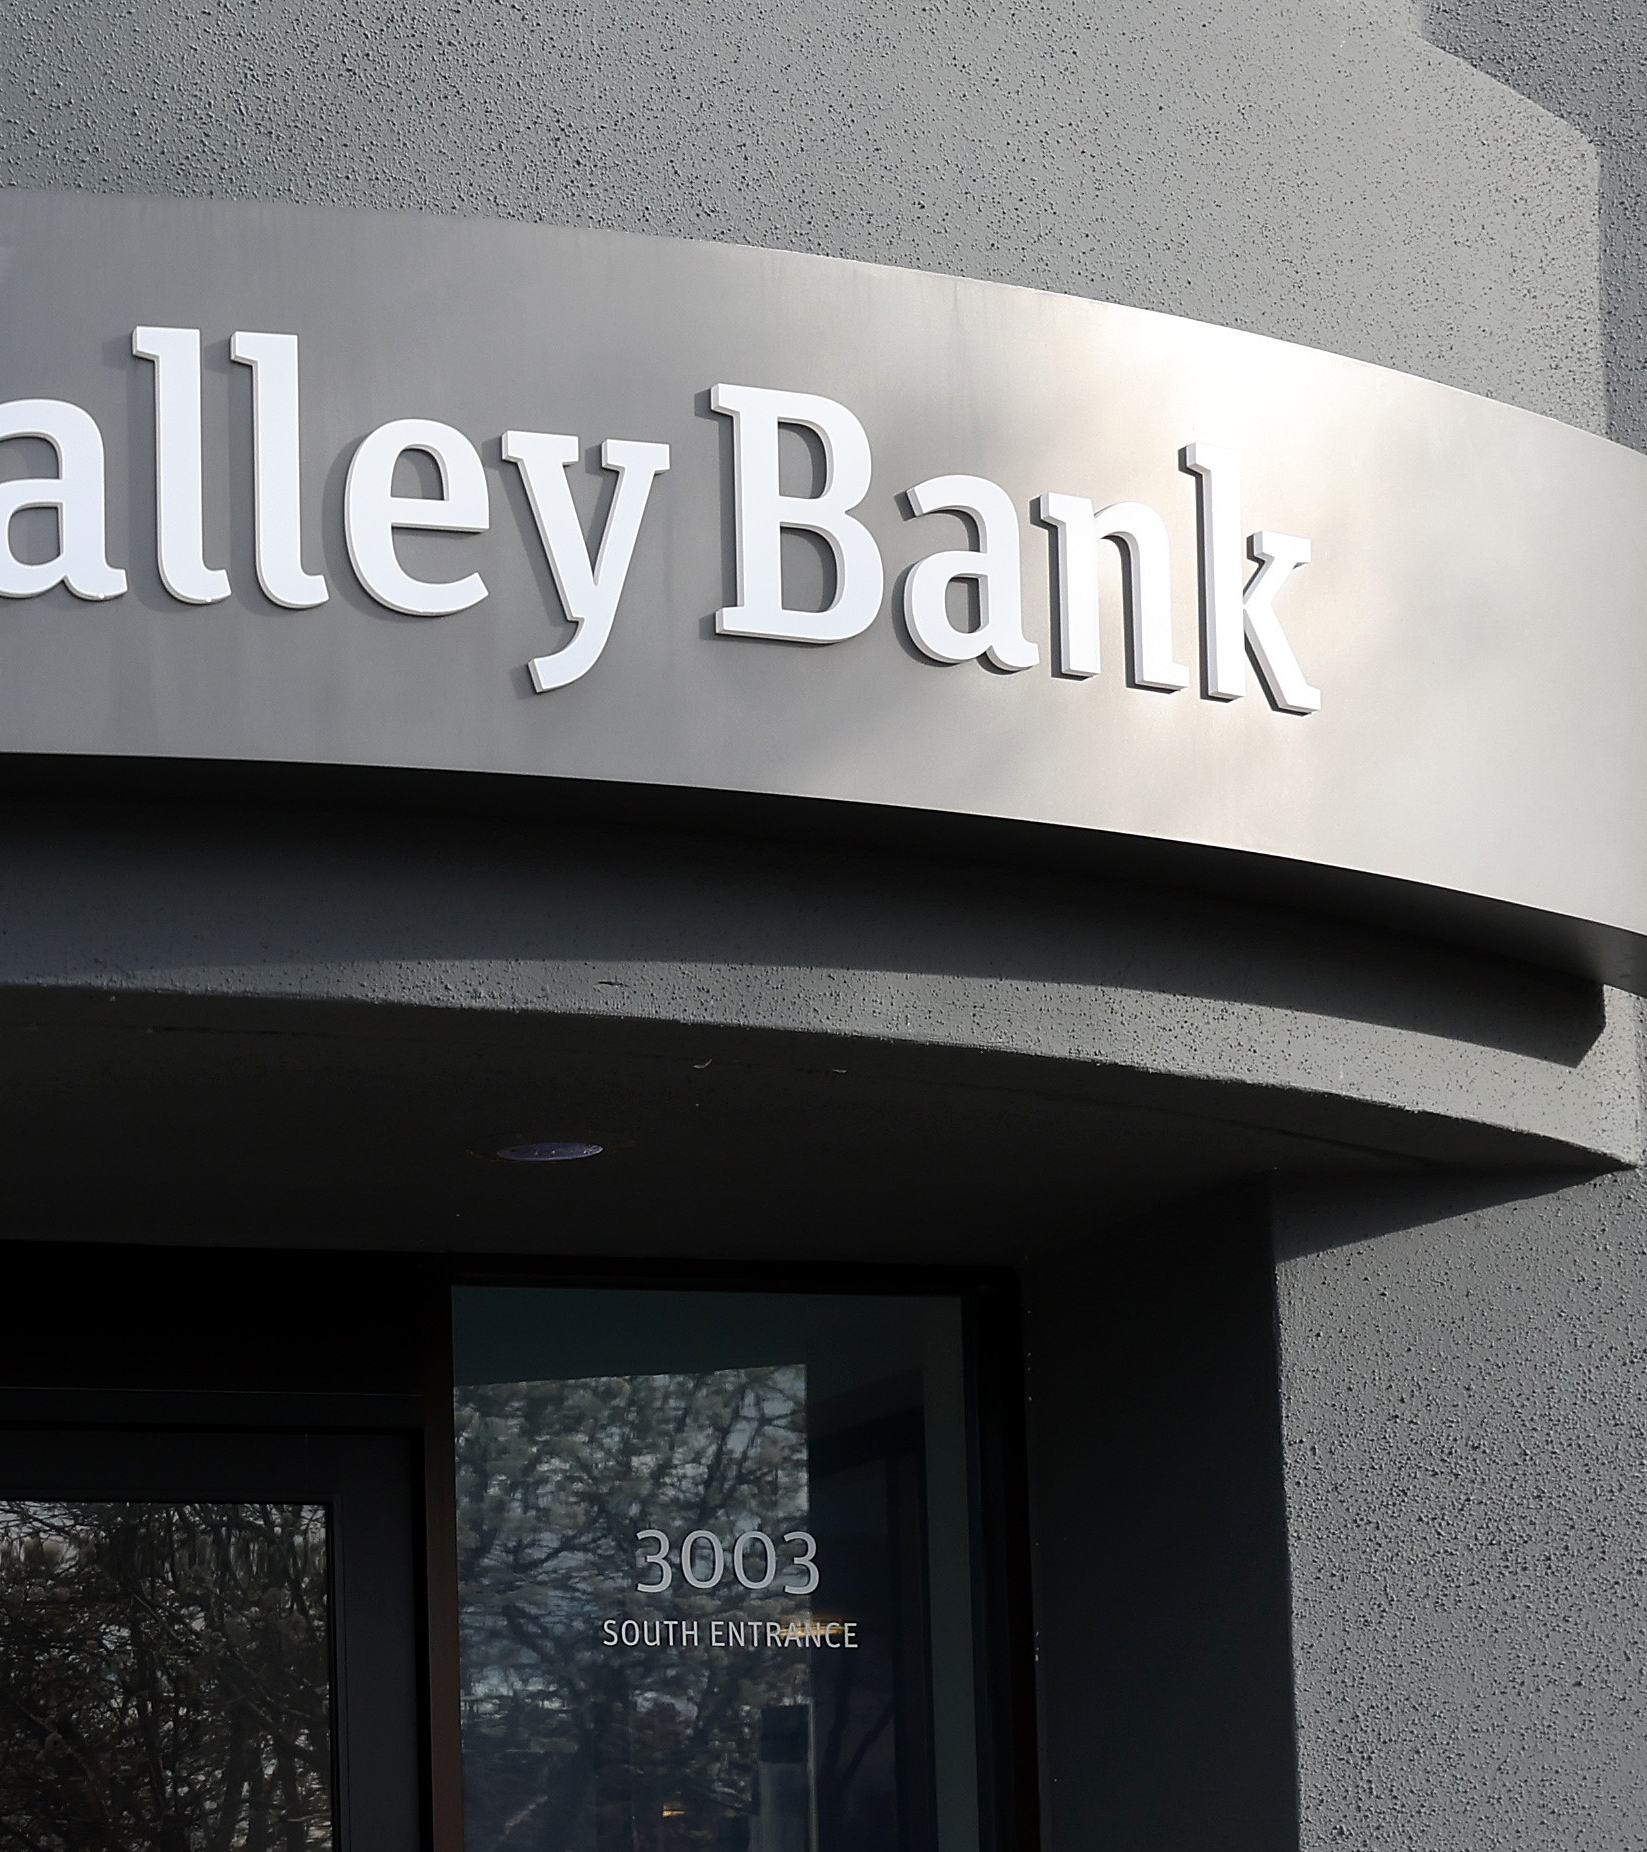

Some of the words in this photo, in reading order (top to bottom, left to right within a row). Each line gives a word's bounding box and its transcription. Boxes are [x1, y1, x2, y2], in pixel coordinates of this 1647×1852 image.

[704, 382, 1323, 716] Bank
[635, 1529, 820, 1595] 3003
[603, 1620, 699, 1647] SOUTH
[710, 1621, 859, 1649] ENTRANCE
